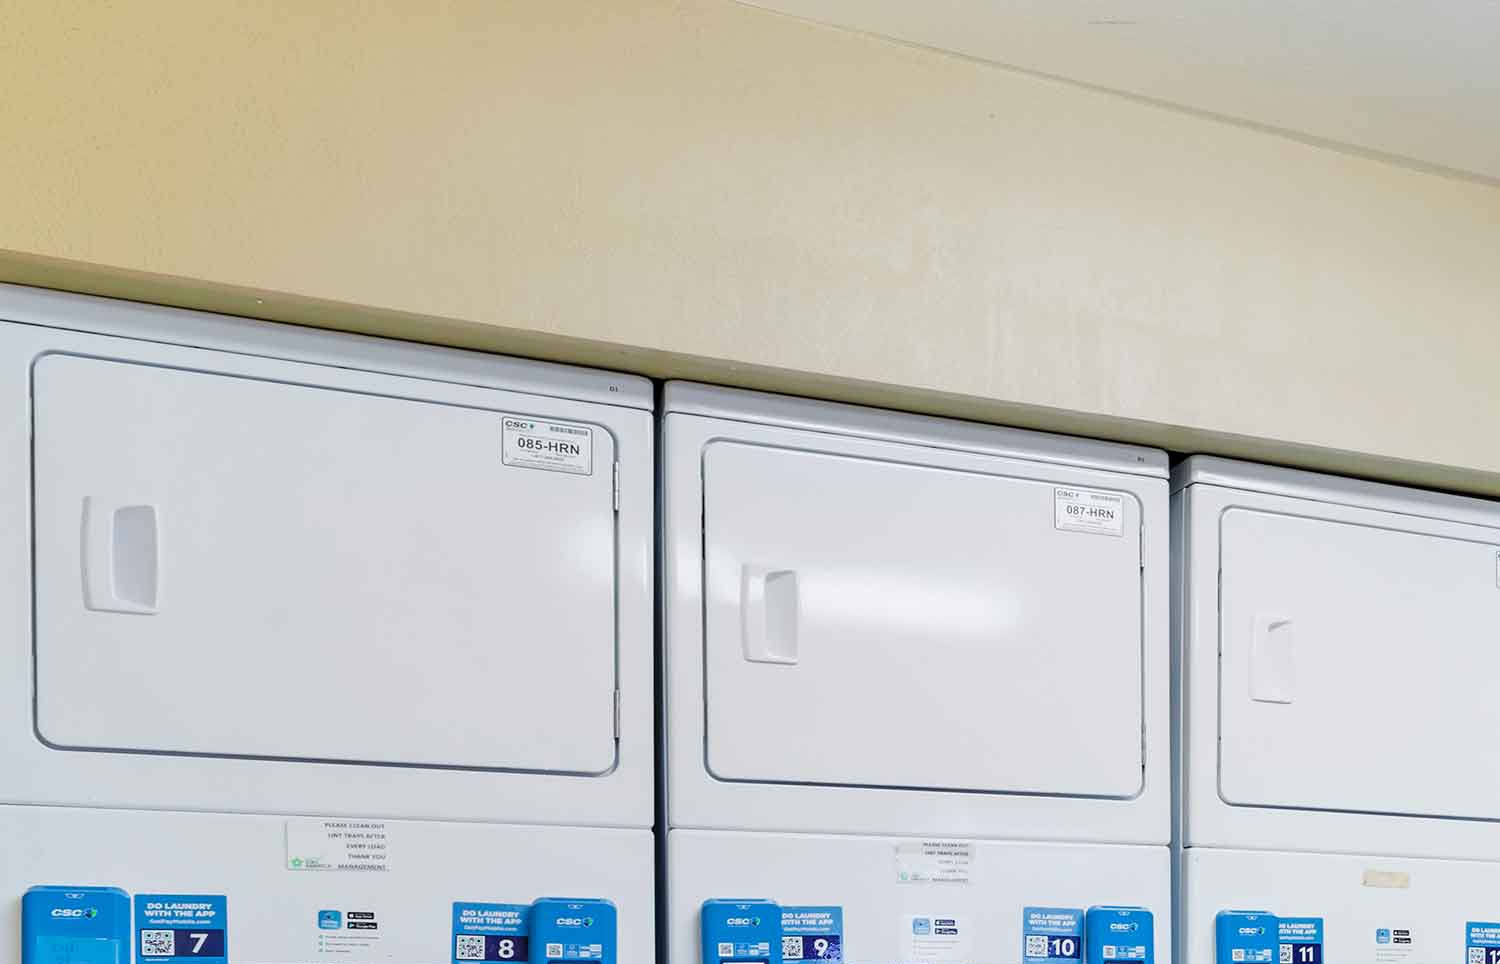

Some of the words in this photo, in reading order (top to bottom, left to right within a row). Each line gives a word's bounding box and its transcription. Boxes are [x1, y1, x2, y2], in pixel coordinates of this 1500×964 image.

[505, 420, 527, 429] CSC
[518, 437, 580, 455] 085-HRN
[1066, 505, 1114, 519] 087-HRN
[51, 908, 82, 918] CSC
[556, 918, 582, 926] CSC
[190, 933, 208, 954] 7
[498, 939, 514, 958] 8
[814, 938, 828, 958] 9
[1053, 939, 1074, 956] 10
[1299, 946, 1314, 962] 11
